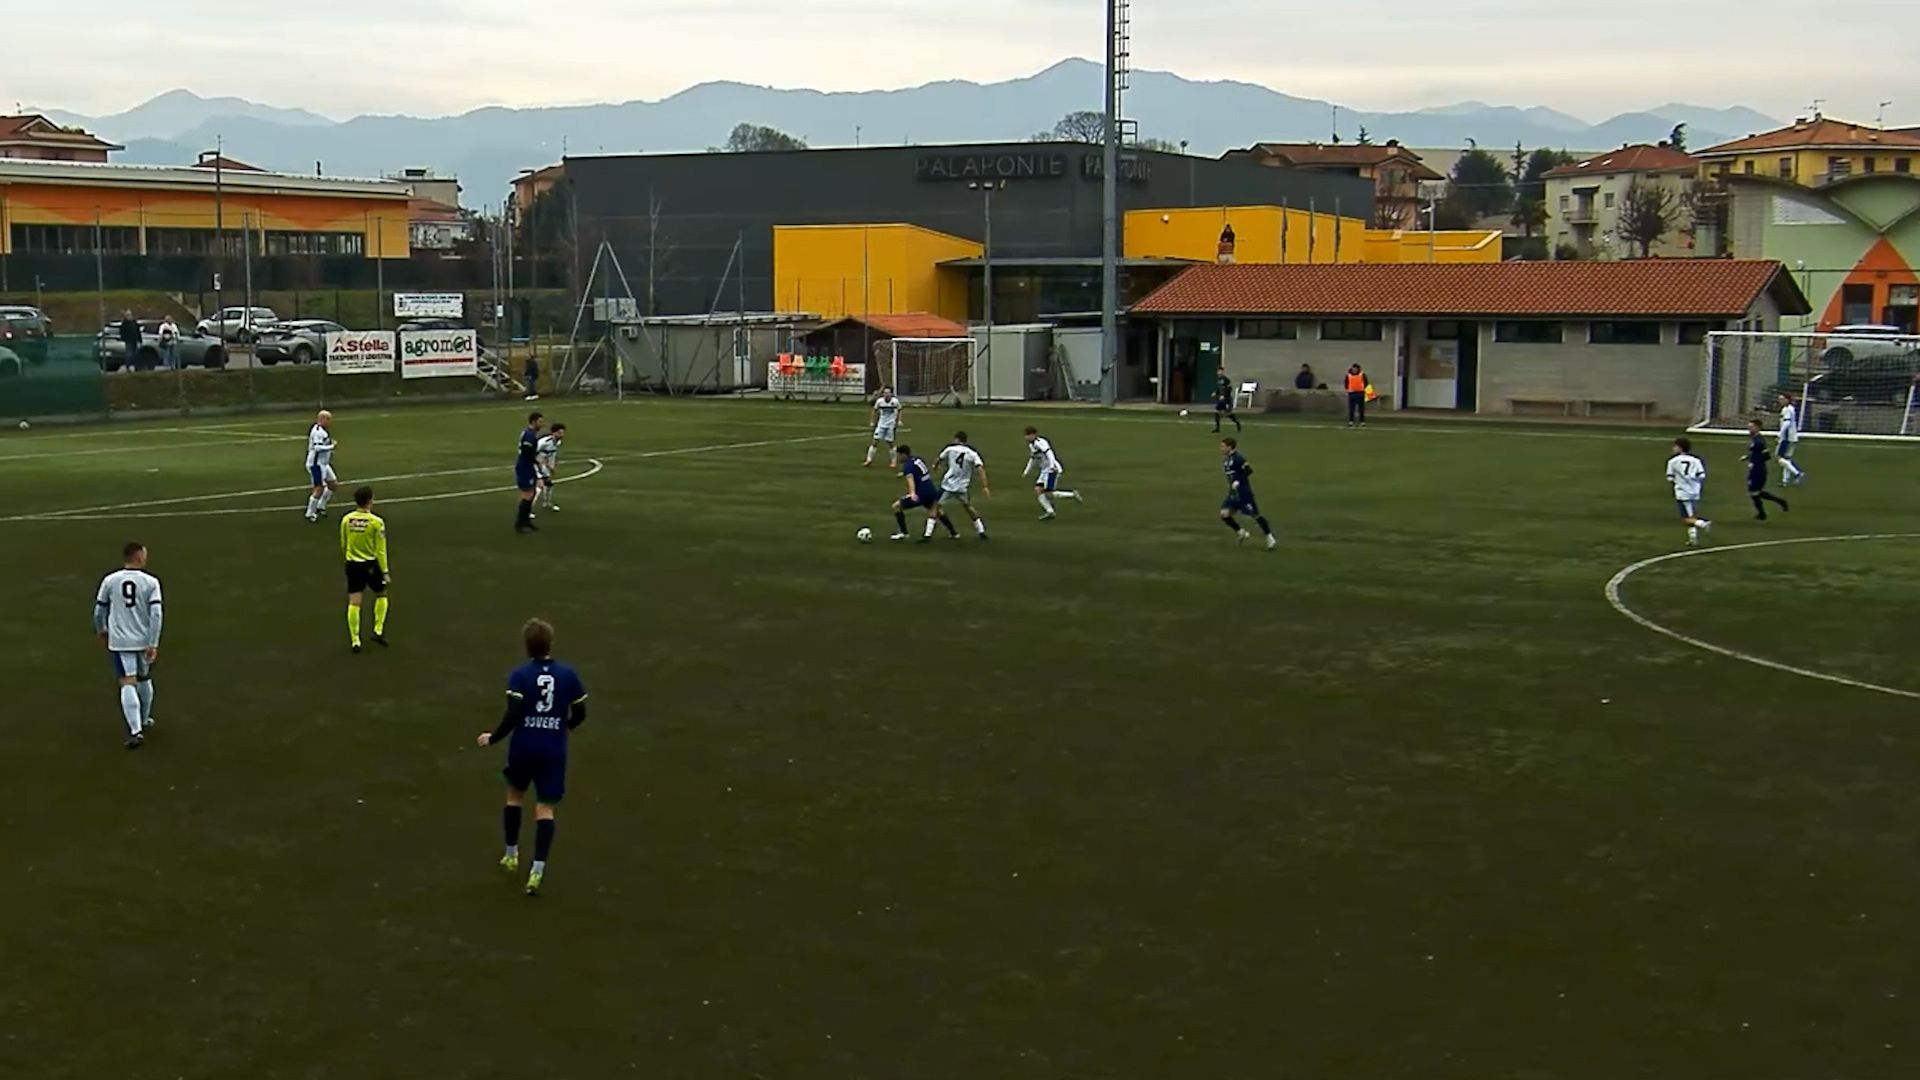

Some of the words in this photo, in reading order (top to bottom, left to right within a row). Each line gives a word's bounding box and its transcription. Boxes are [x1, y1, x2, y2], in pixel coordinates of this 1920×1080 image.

[405, 336, 473, 356] agromed
[956, 452, 966, 468] 4
[1681, 461, 1690, 475] 7
[122, 580, 136, 608] 9
[536, 675, 555, 712] 3
